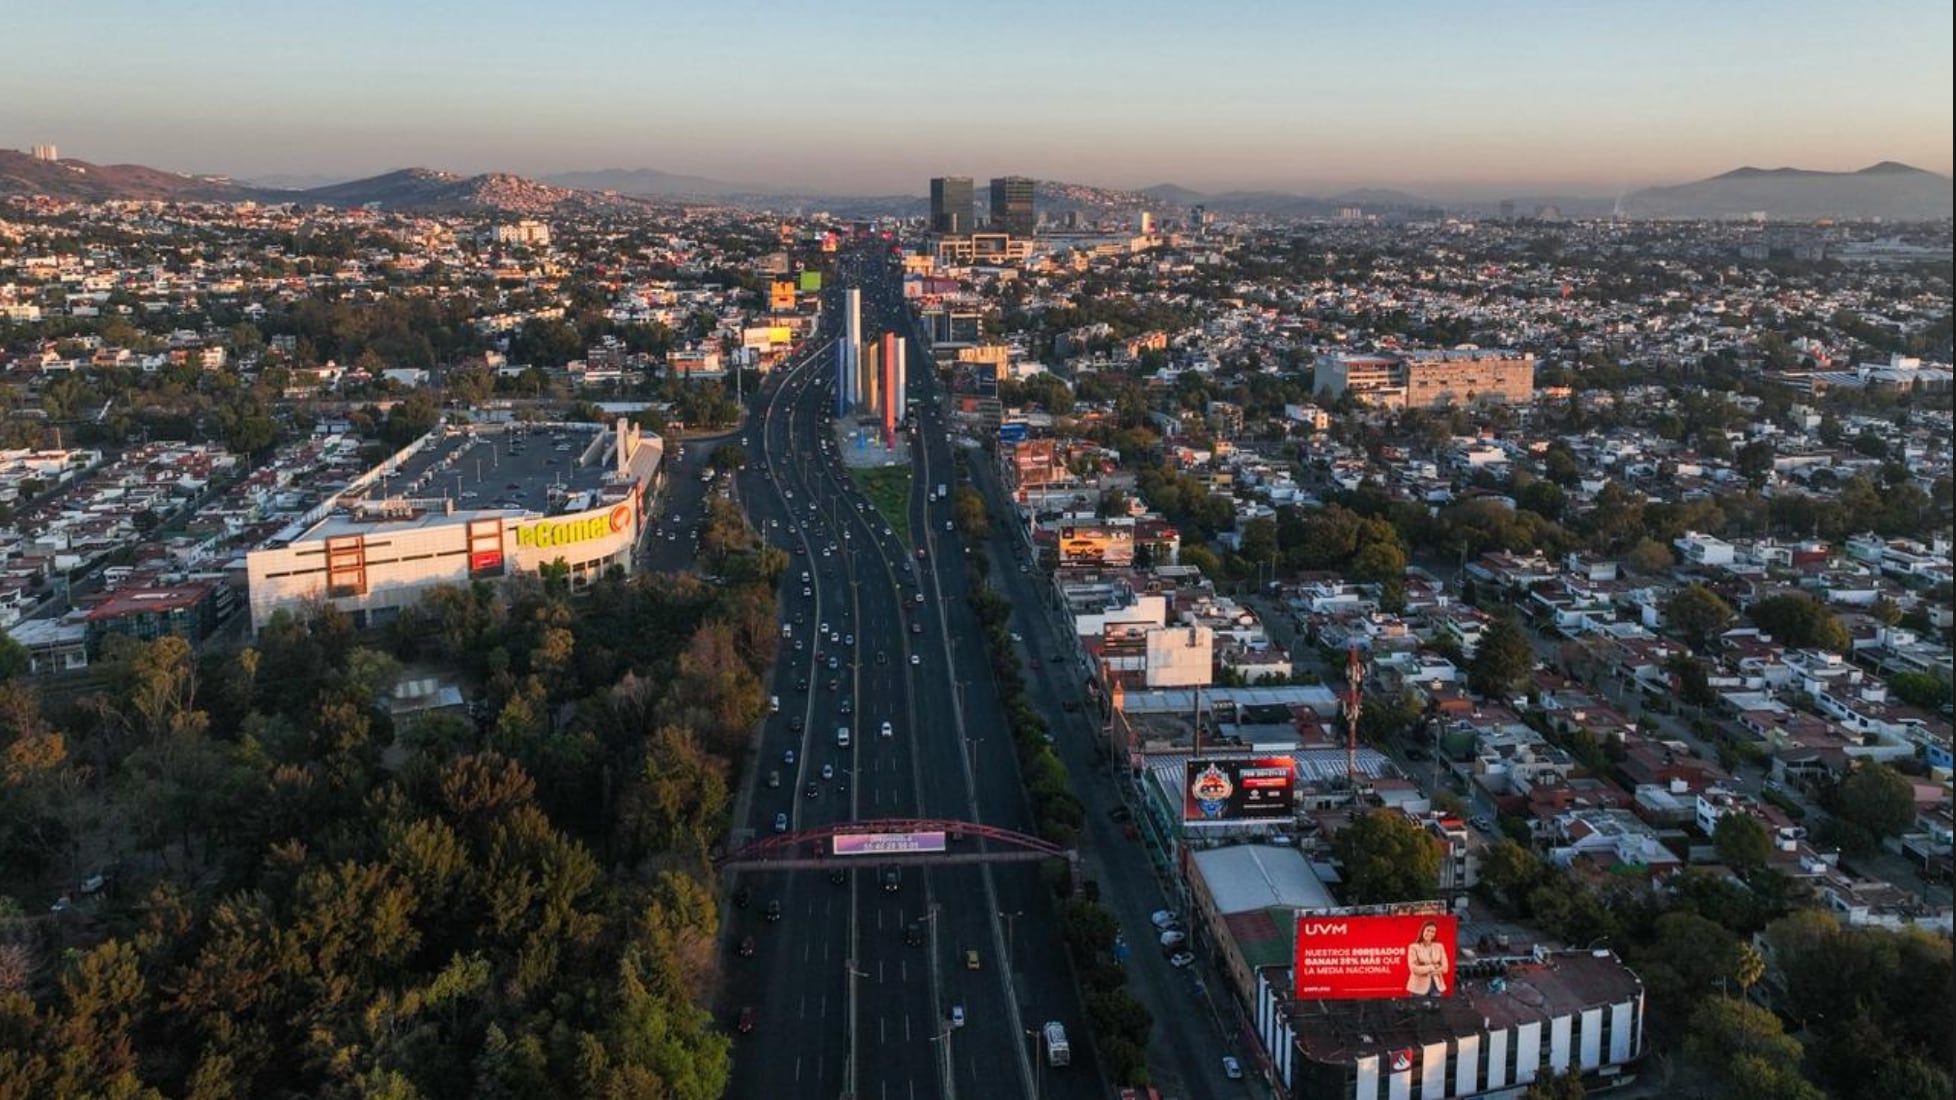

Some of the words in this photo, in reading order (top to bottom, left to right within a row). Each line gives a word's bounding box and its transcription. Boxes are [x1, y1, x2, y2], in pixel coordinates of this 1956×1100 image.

[1305, 923, 1347, 936] UVM
[1304, 948, 1350, 957] NUESTROS
[1352, 947, 1405, 956] EGRESADOS
[1304, 957, 1338, 966] GANAN
[1382, 956, 1400, 965] QUE
[1304, 967, 1315, 975] LA
[1316, 967, 1344, 975] MEDIA
[1345, 966, 1391, 974] NACIONAL
